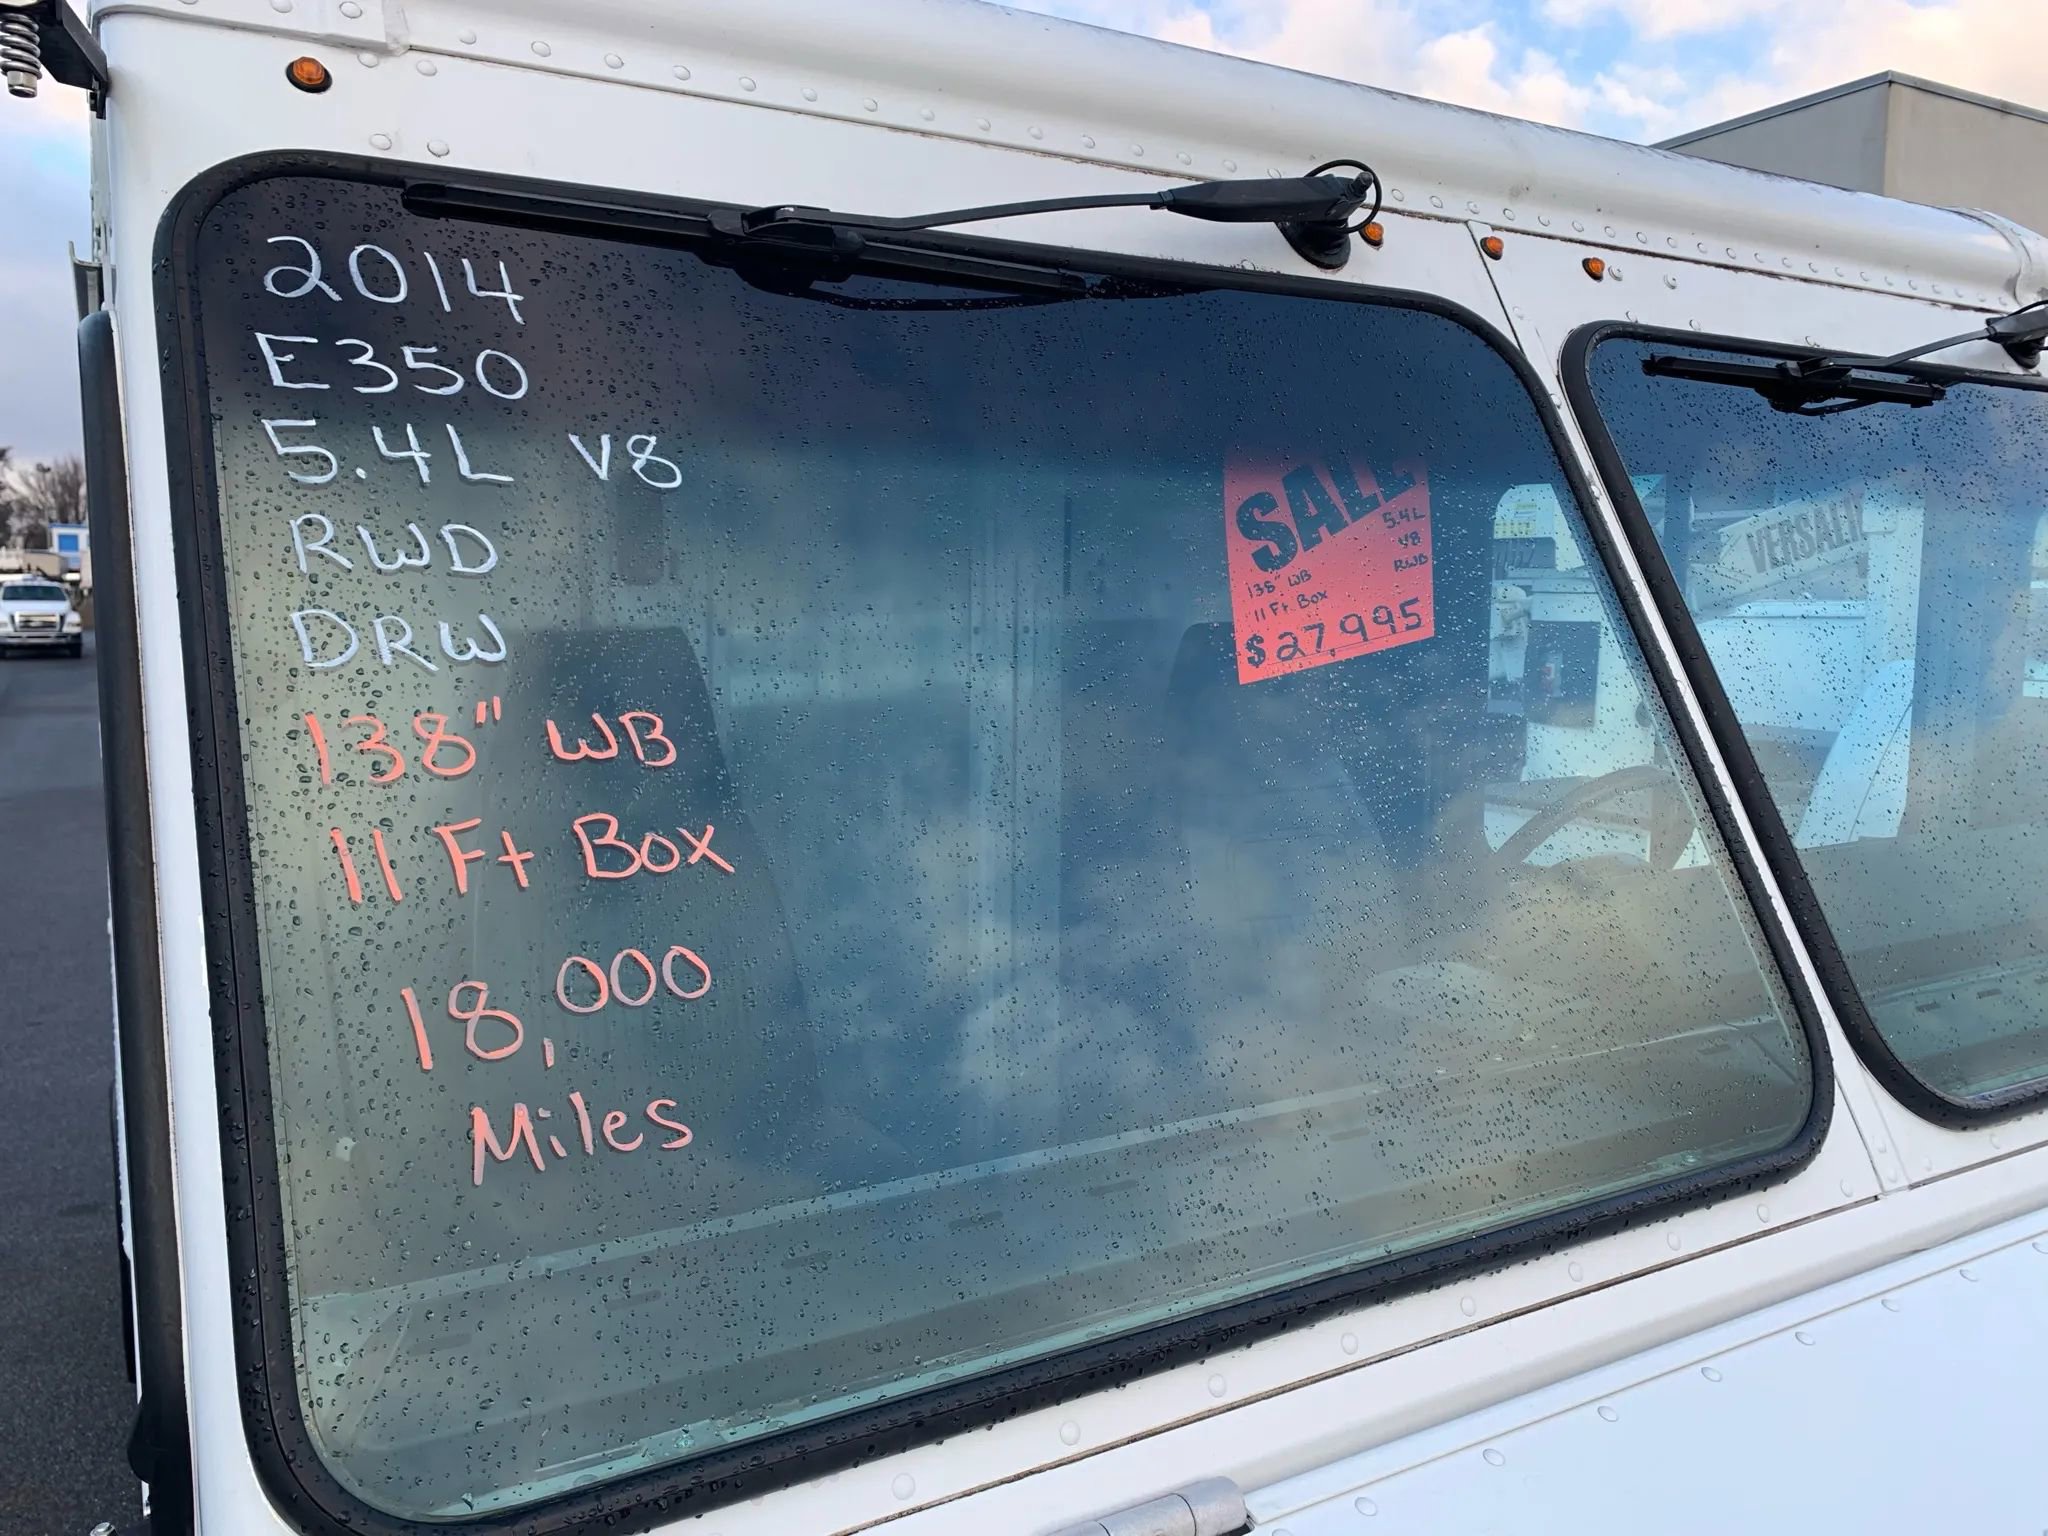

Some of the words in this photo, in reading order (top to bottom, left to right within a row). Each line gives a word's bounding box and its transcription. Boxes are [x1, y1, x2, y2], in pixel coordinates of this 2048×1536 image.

[264, 235, 525, 325] 2014
[255, 332, 528, 399] E350
[261, 418, 514, 484] 5.4L
[568, 433, 683, 489] V8
[289, 513, 498, 574] RWD
[1382, 507, 1426, 529] 5.4L
[1254, 607, 1267, 622] 11
[1269, 601, 1289, 616] Ft
[1296, 590, 1329, 609] Box
[1287, 569, 1312, 587] WB
[289, 608, 507, 672] DRW
[305, 695, 501, 786] 138"
[547, 711, 678, 767] WB
[330, 826, 403, 904] 11
[432, 817, 535, 894] Ft
[573, 812, 736, 880] Box
[401, 945, 712, 1071] 18,000
[470, 1091, 694, 1187] Miles
